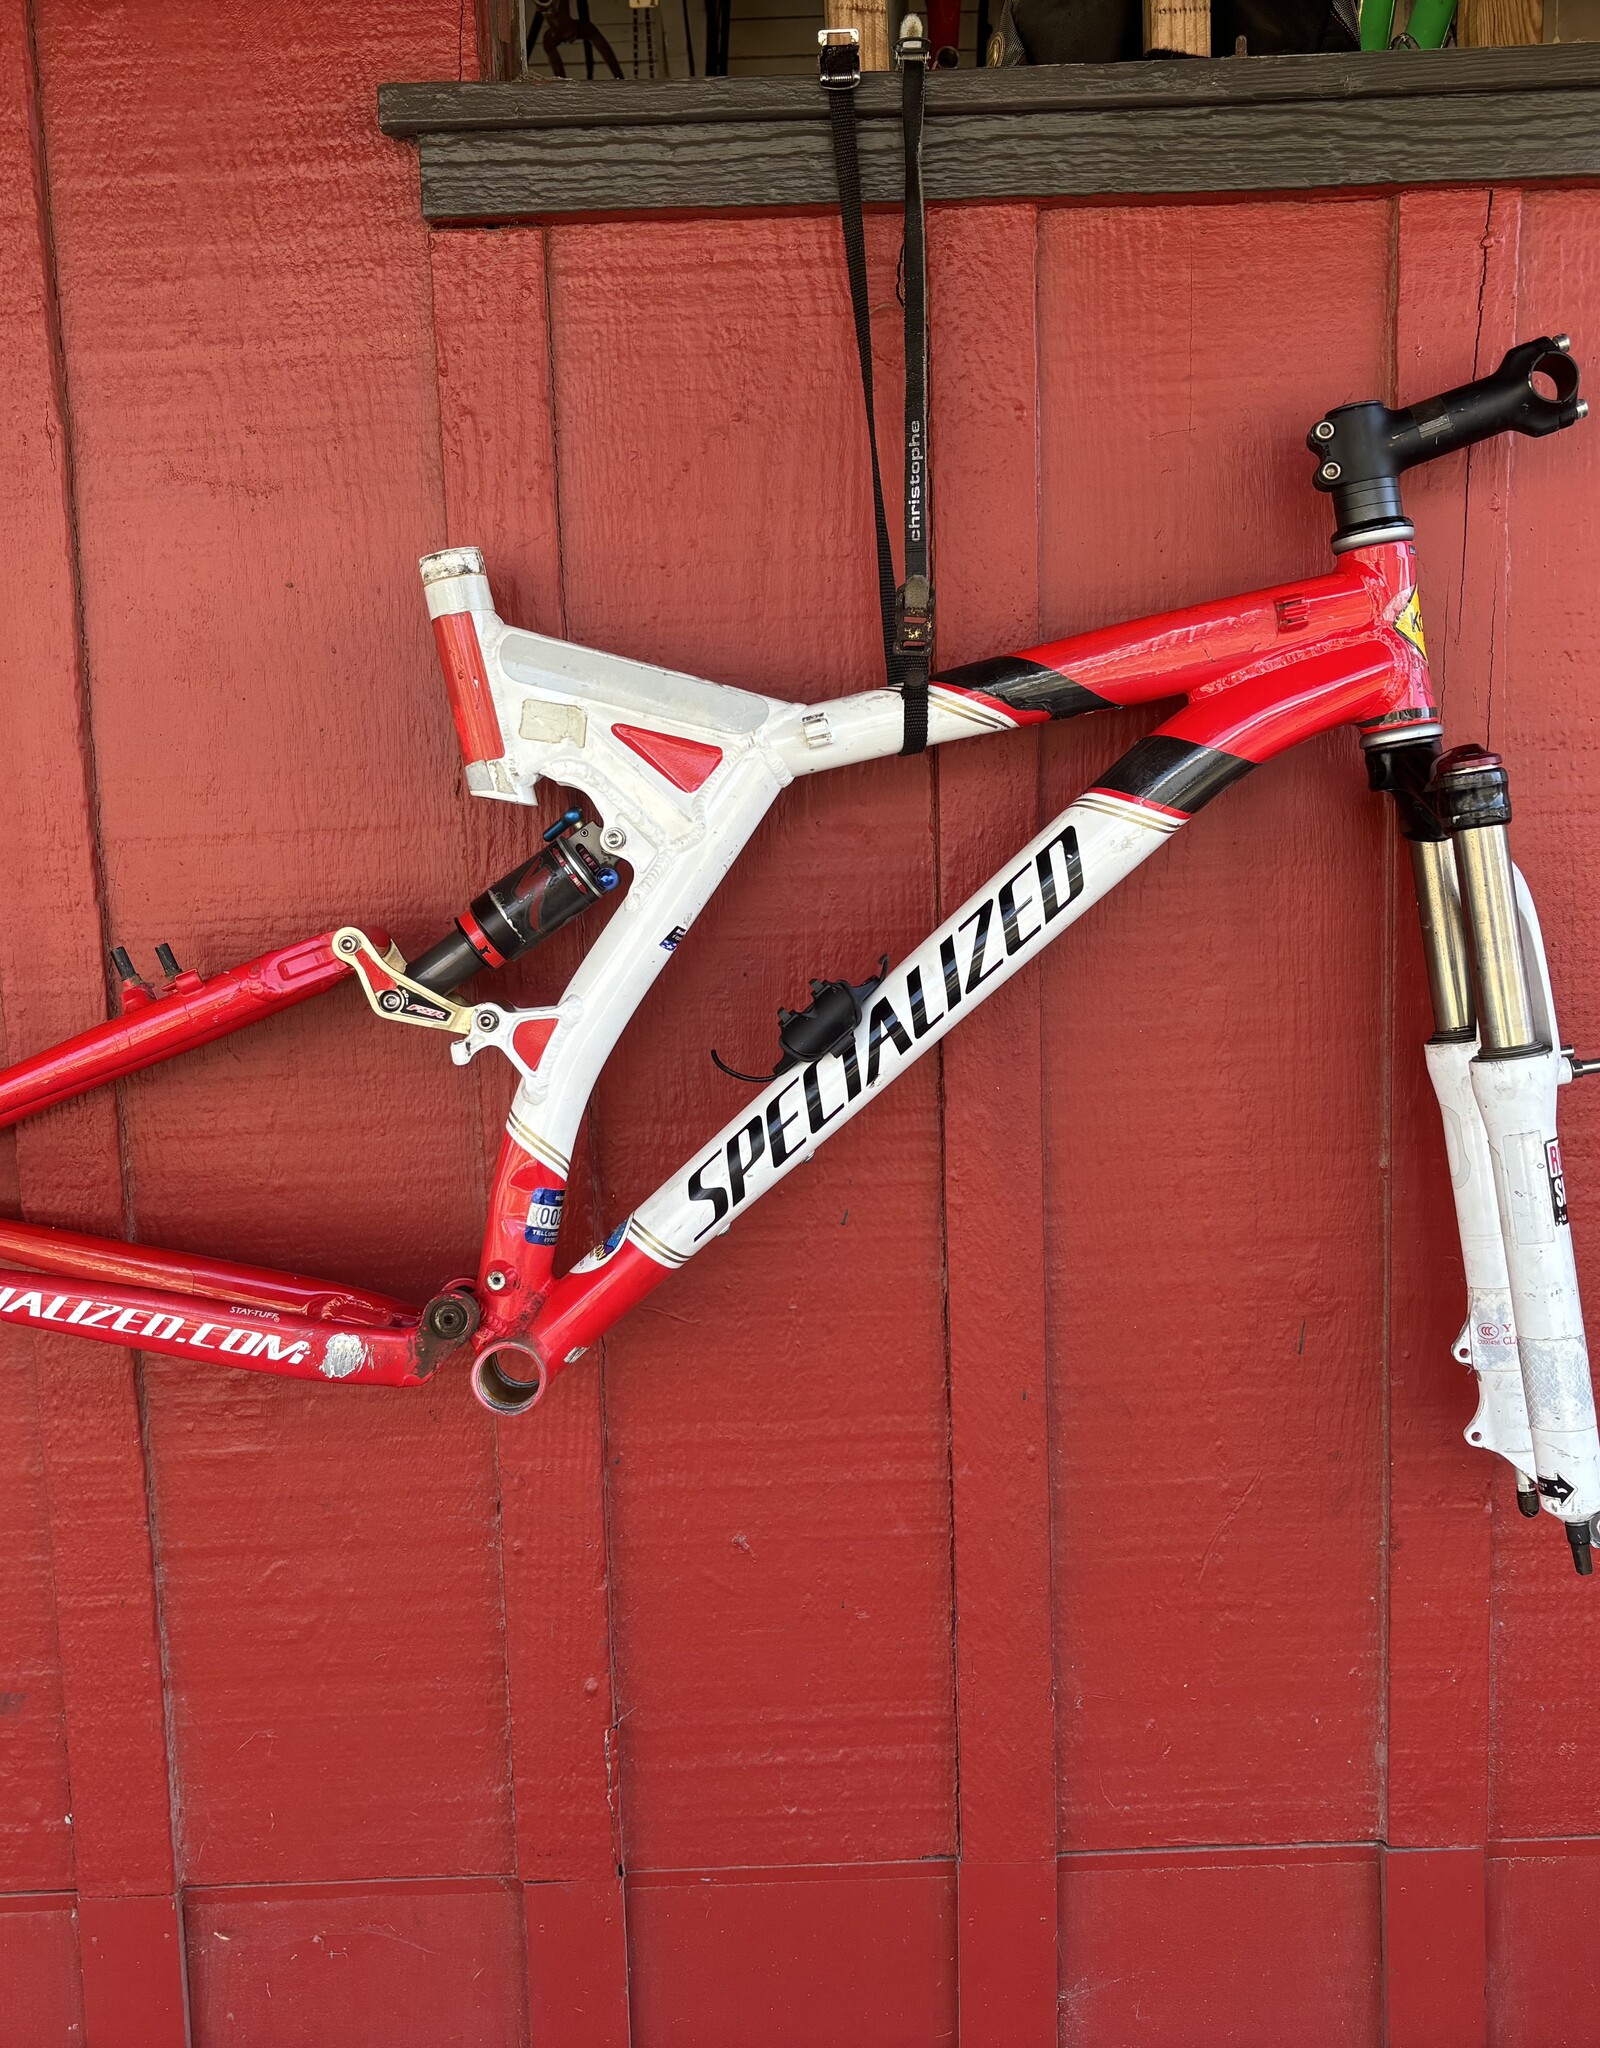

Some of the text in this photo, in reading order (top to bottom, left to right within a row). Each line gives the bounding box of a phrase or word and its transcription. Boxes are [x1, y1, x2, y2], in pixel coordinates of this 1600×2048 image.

[908, 420, 924, 541] christophe
[687, 825, 1085, 1243] SPECIALIZED
[0, 1285, 311, 1365] IALIZED.COM
